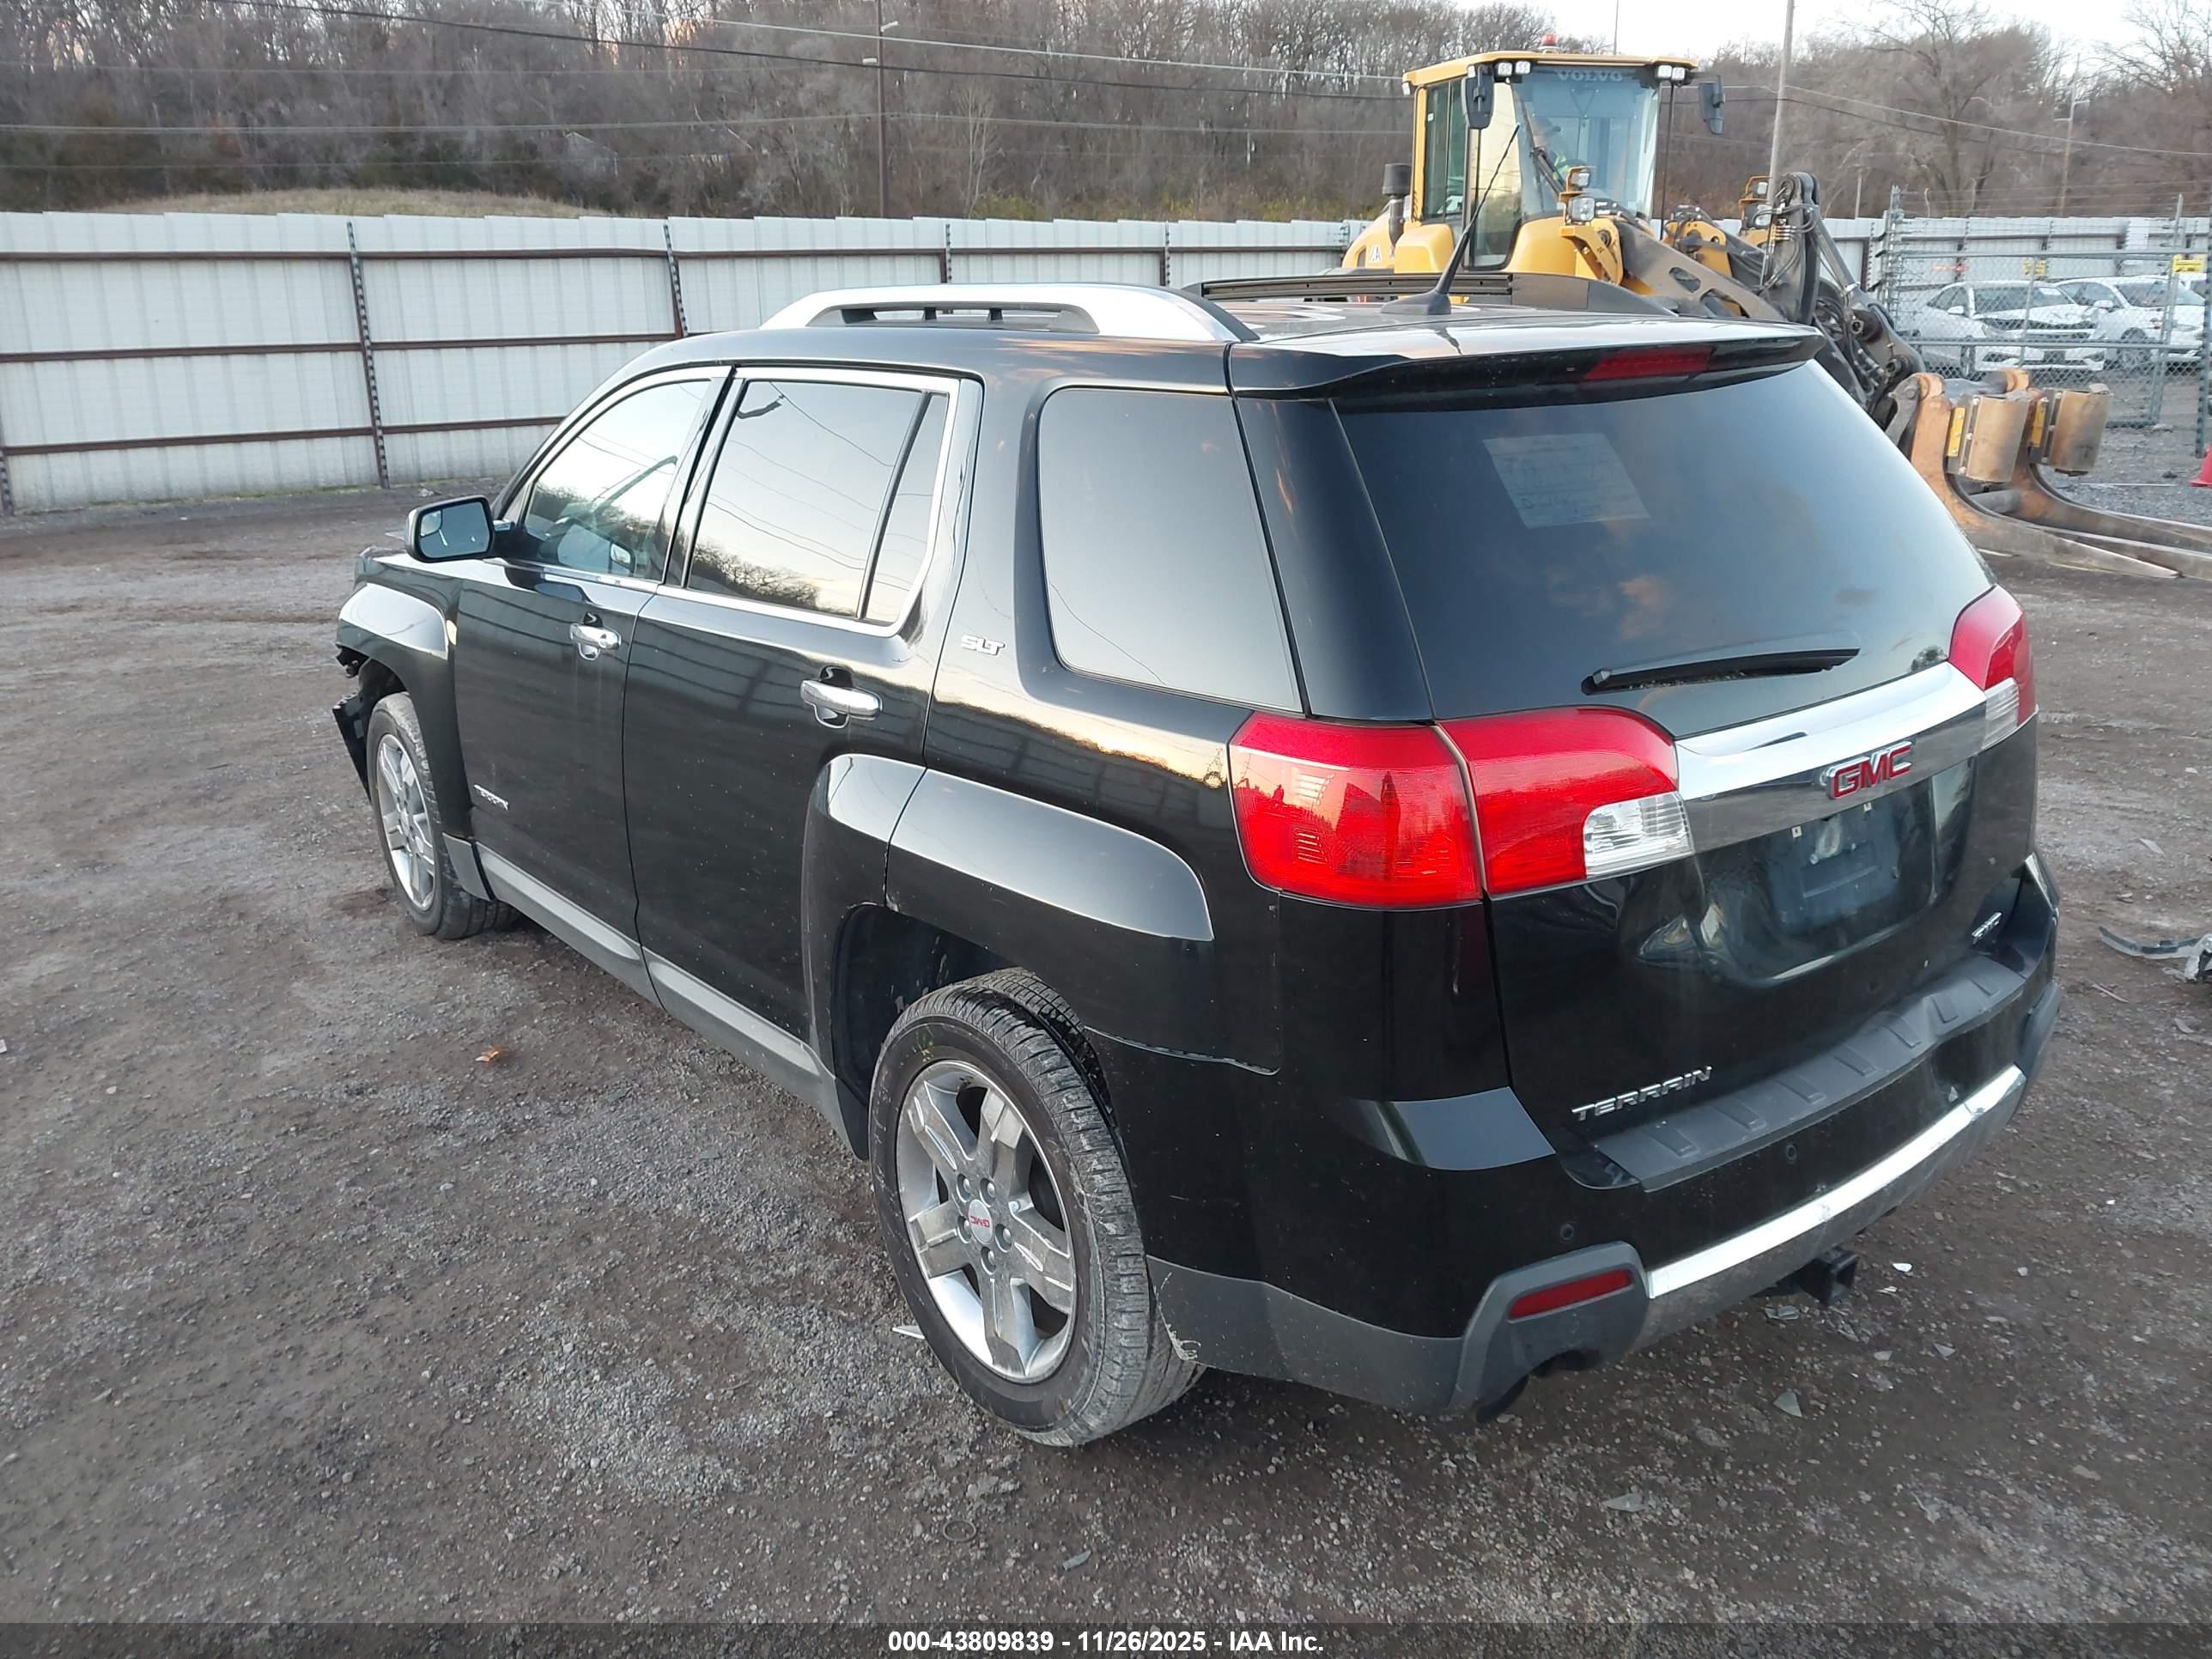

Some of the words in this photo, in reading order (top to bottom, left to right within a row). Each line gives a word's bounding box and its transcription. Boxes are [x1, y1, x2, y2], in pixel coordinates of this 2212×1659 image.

[1553, 70, 1624, 82] VOLVO
[961, 633, 1006, 656] SLT
[1826, 740, 1912, 799] GMC
[1571, 1066, 1712, 1121] TERRAIN
[969, 1215, 991, 1228] GMC
